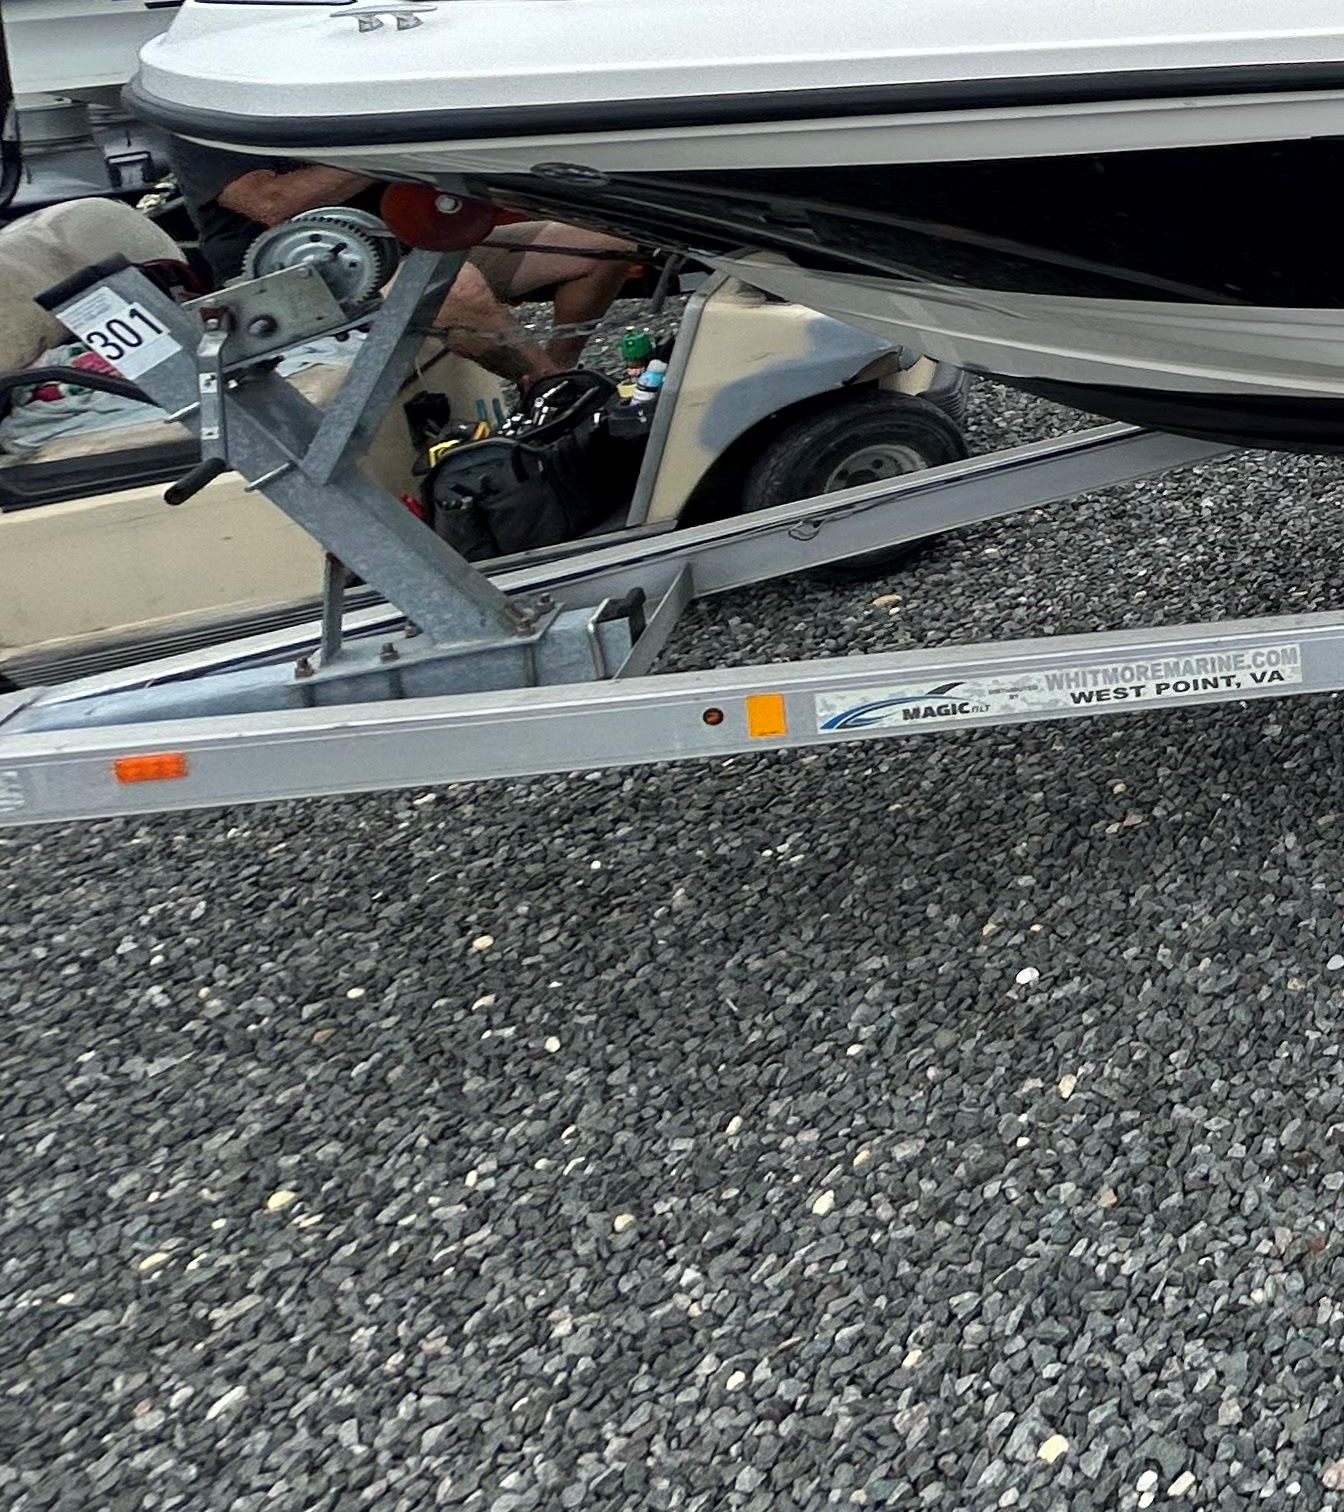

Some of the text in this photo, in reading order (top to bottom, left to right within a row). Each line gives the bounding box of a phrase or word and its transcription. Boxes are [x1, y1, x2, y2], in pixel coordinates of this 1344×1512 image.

[86, 308, 164, 361] 301
[1044, 646, 1298, 691] WHITMOREMARINE.COM
[1070, 670, 1285, 705] WEST POINT, VA
[902, 702, 970, 721] MAGIC
